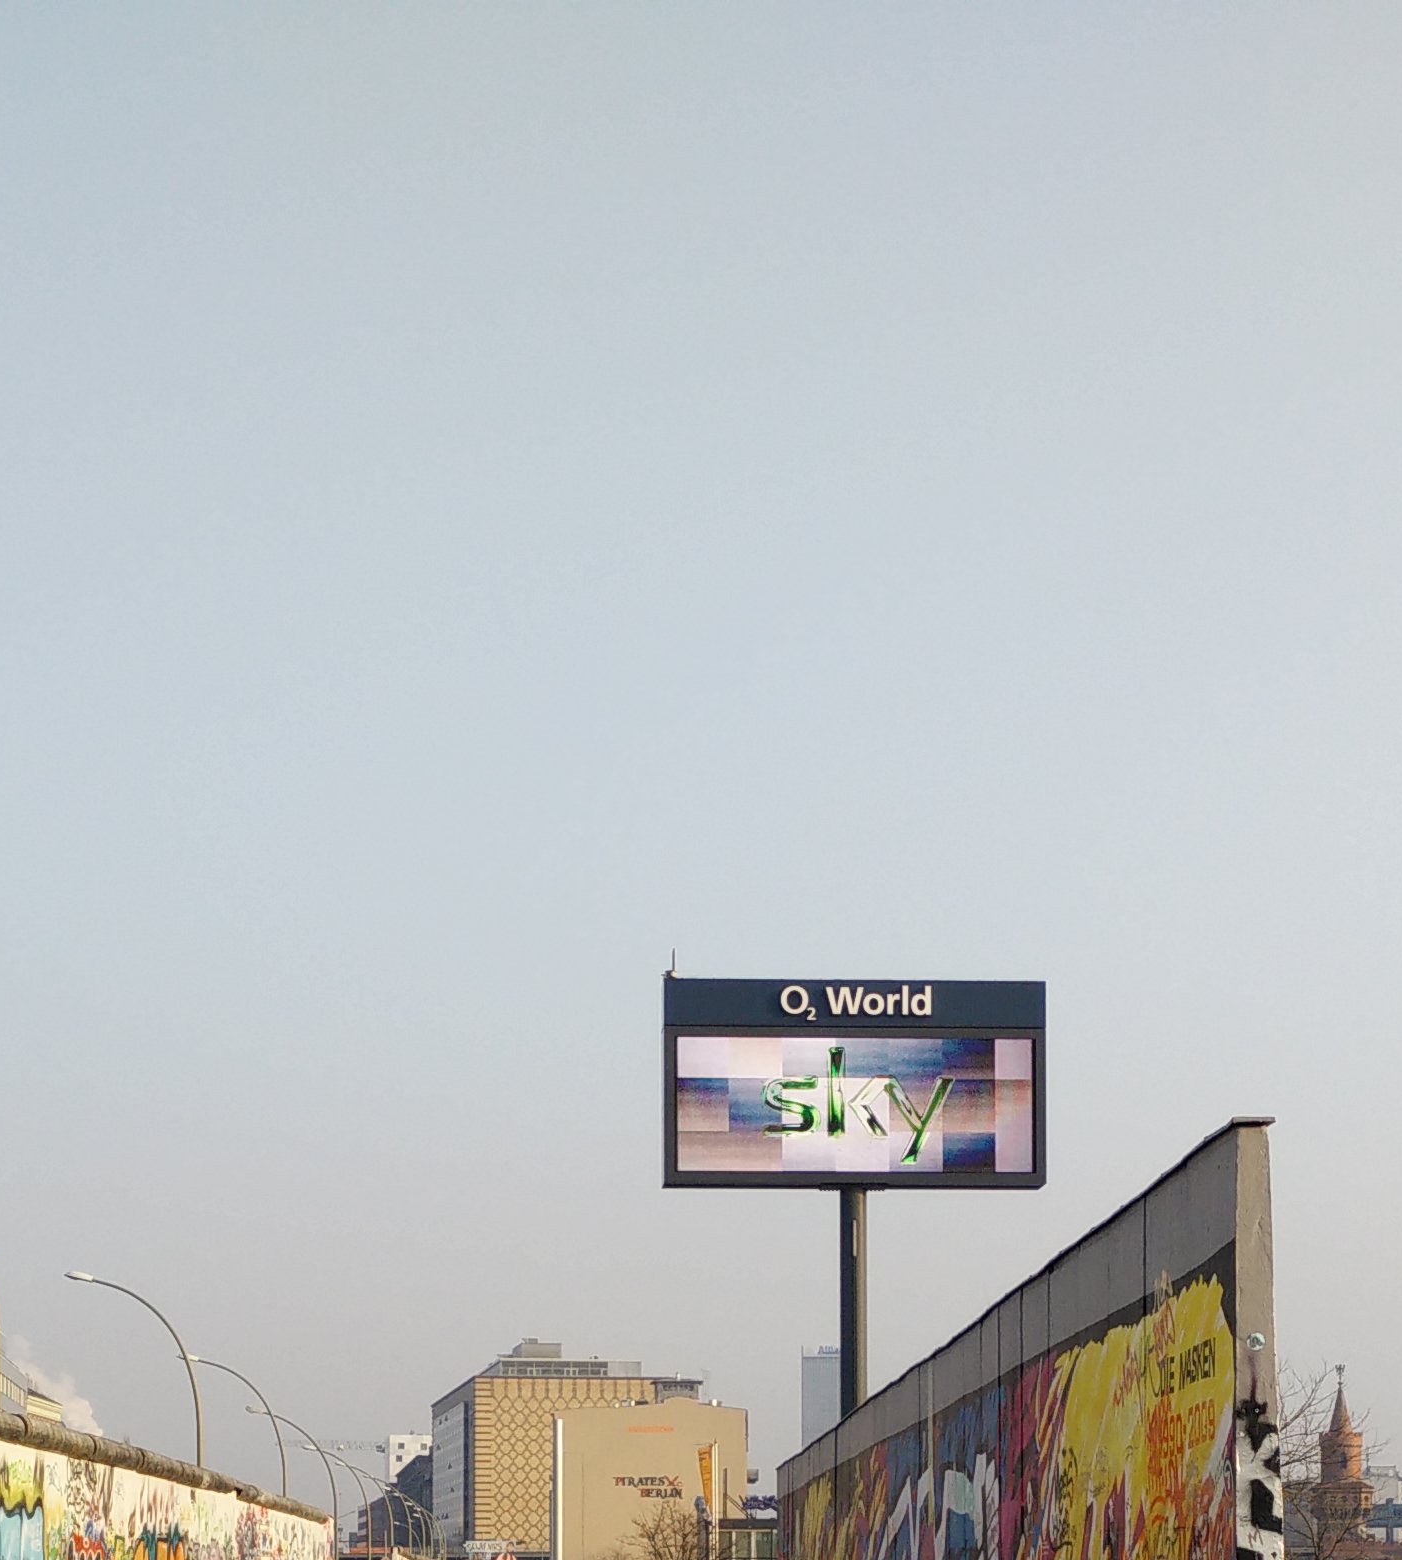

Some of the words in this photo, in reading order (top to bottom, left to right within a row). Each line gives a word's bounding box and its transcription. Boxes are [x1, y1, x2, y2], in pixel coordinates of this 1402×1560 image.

[825, 984, 934, 1017] World
[760, 1046, 955, 1166] sky
[1178, 1337, 1216, 1391] MASKEN
[612, 1475, 665, 1489] PIRATES
[638, 1487, 683, 1500] BERLIN
